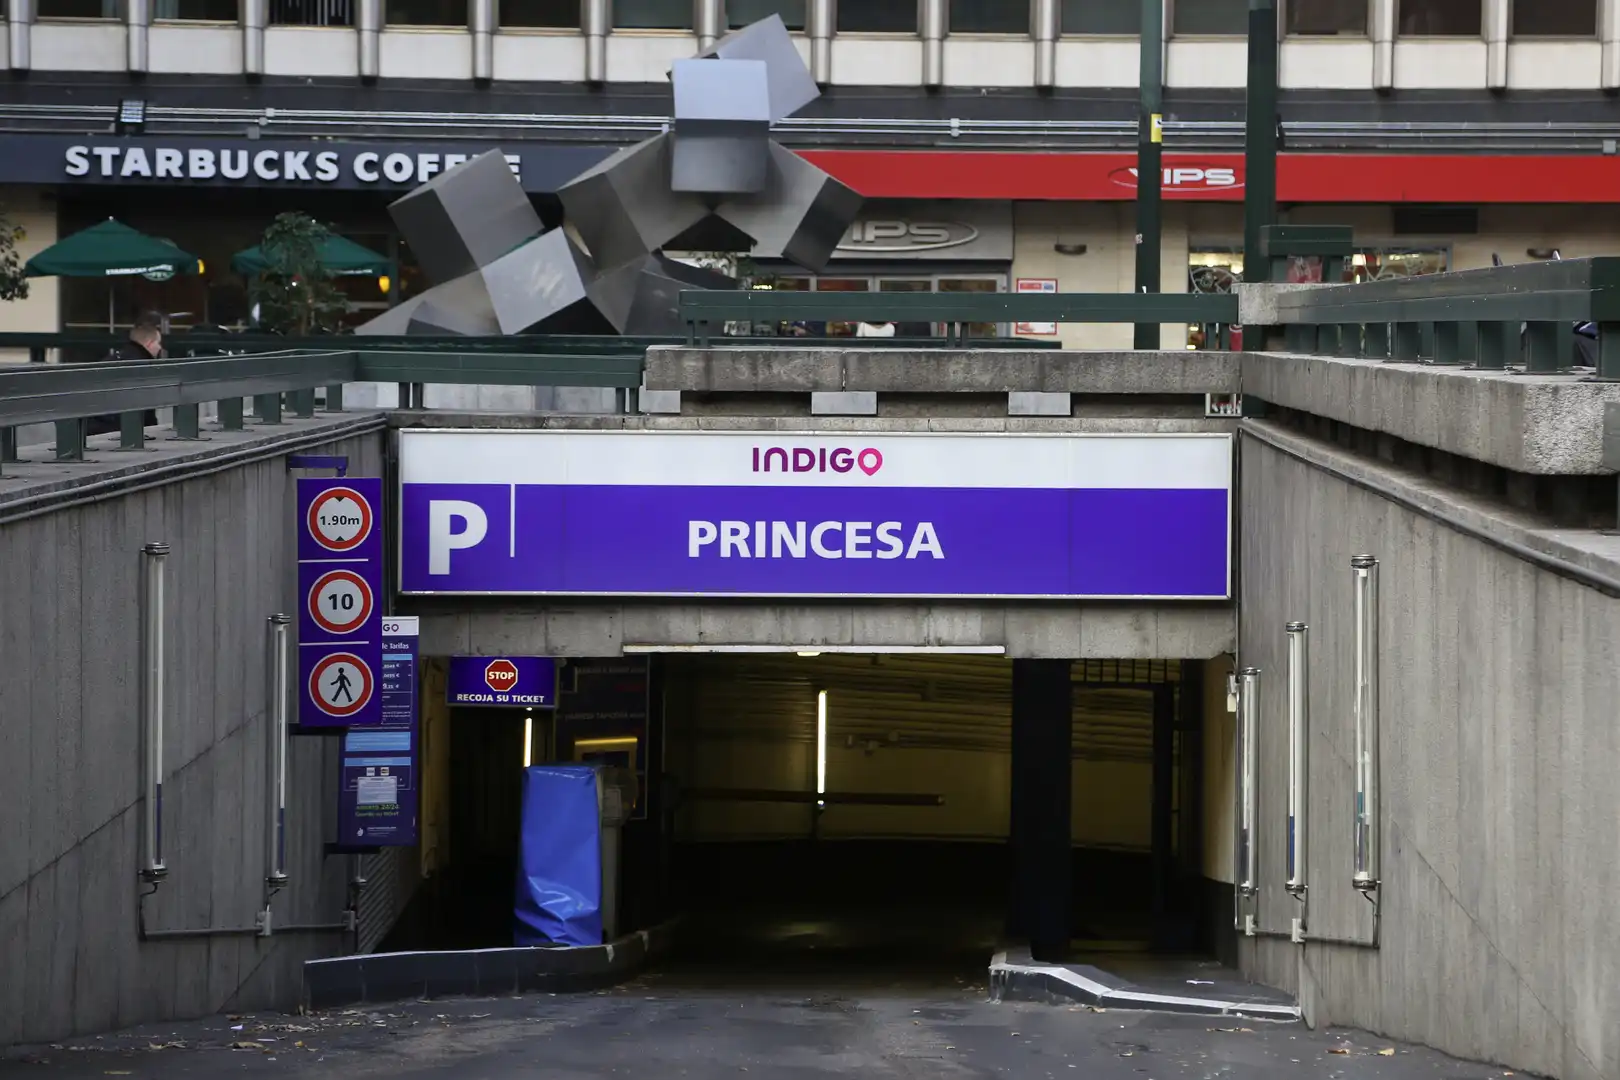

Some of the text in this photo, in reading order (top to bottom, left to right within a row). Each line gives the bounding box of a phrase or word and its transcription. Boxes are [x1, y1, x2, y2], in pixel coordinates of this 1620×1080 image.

[65, 145, 521, 183] STARBUCKS COFFE
[1128, 168, 1236, 186] IPS
[852, 220, 950, 244] IPS
[752, 446, 883, 477] INDIGO
[319, 514, 360, 526] 1.90m
[428, 499, 488, 576] P
[688, 520, 945, 560] PRINCESA
[327, 593, 354, 611] 10
[383, 624, 399, 632] GO
[488, 672, 515, 680] STOP
[456, 693, 545, 703] RECOJA SU TICKET
